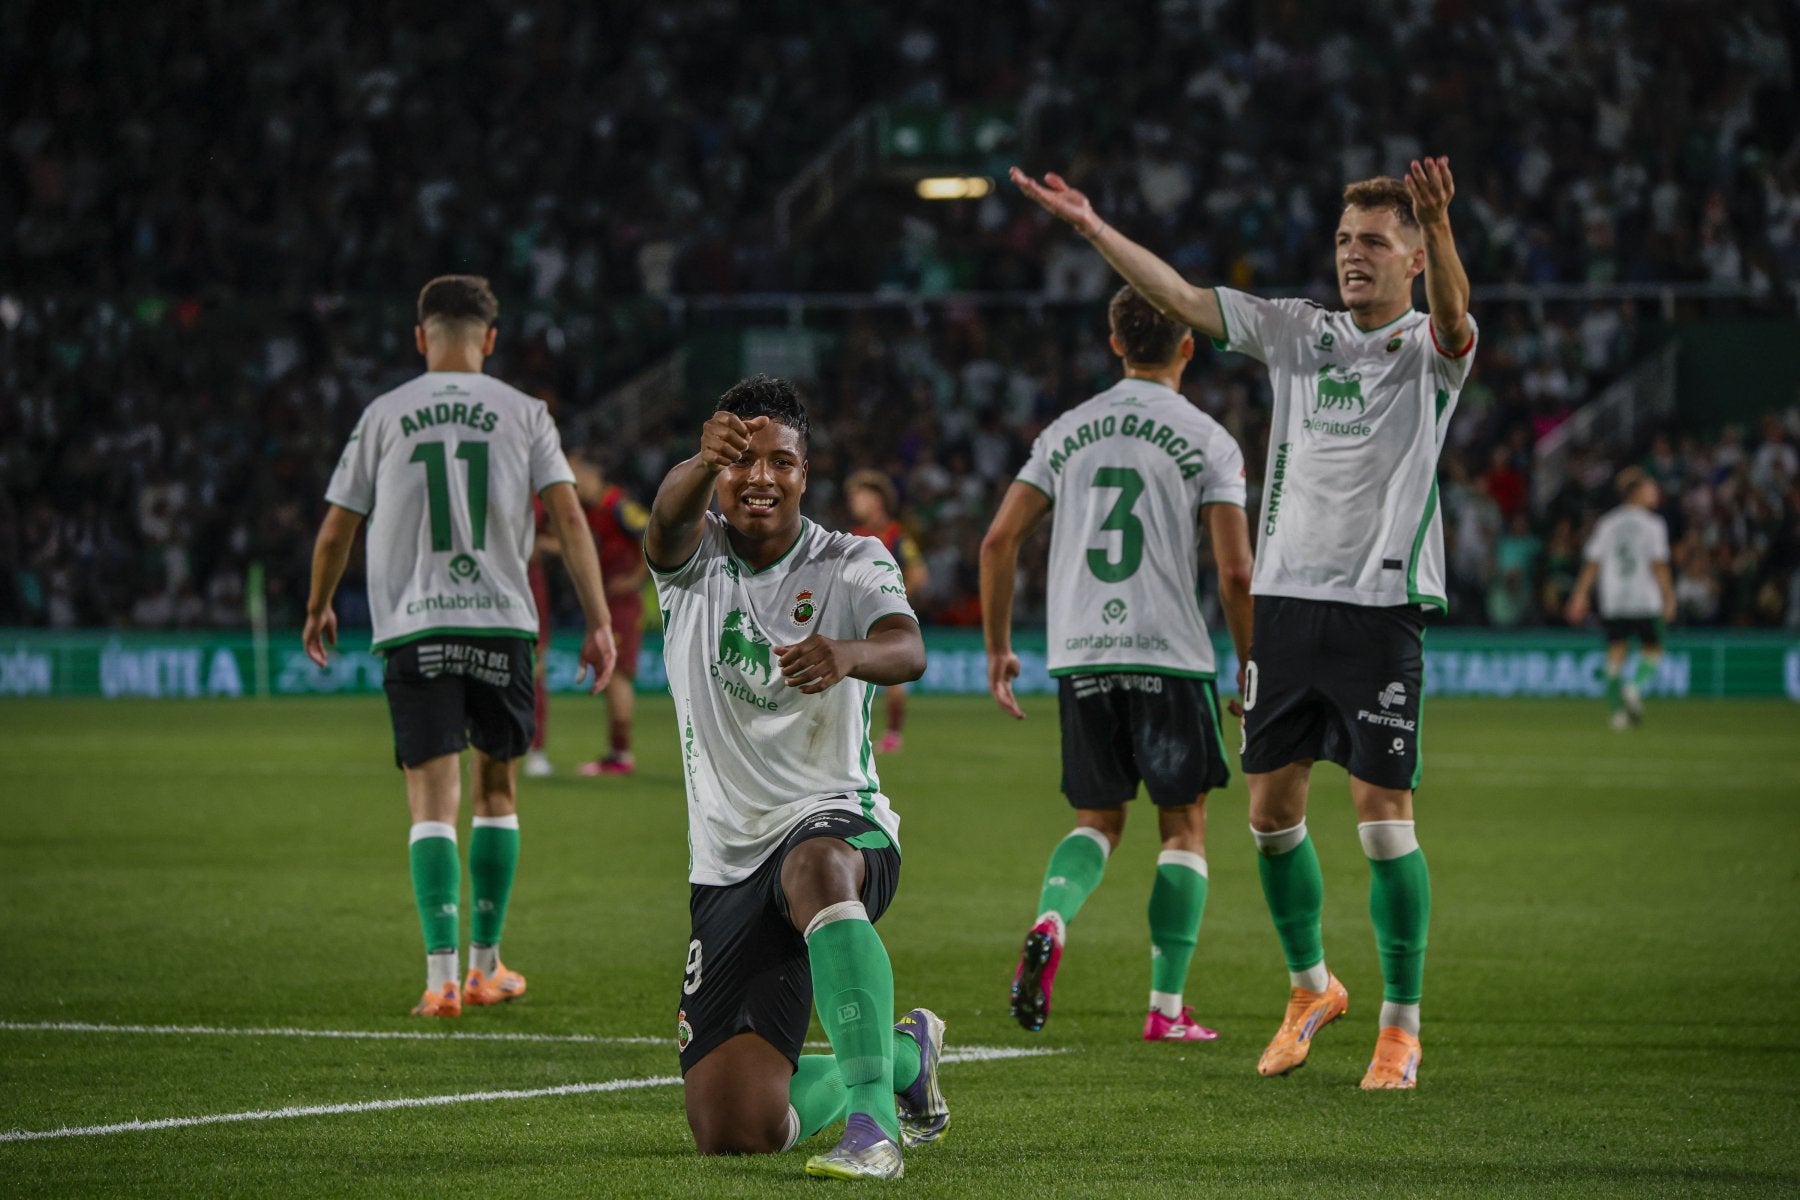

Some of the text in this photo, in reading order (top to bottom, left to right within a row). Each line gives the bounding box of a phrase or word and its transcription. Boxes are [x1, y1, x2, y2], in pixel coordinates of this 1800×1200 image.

[400, 401, 498, 437] ANDRÉS
[1049, 414, 1205, 481] MARIO GARCÍA
[409, 441, 489, 551] 11
[1265, 441, 1291, 537] CANTABRIA
[1086, 466, 1145, 583] 3
[1066, 634, 1133, 651] cantabria
[684, 938, 703, 996] 9
